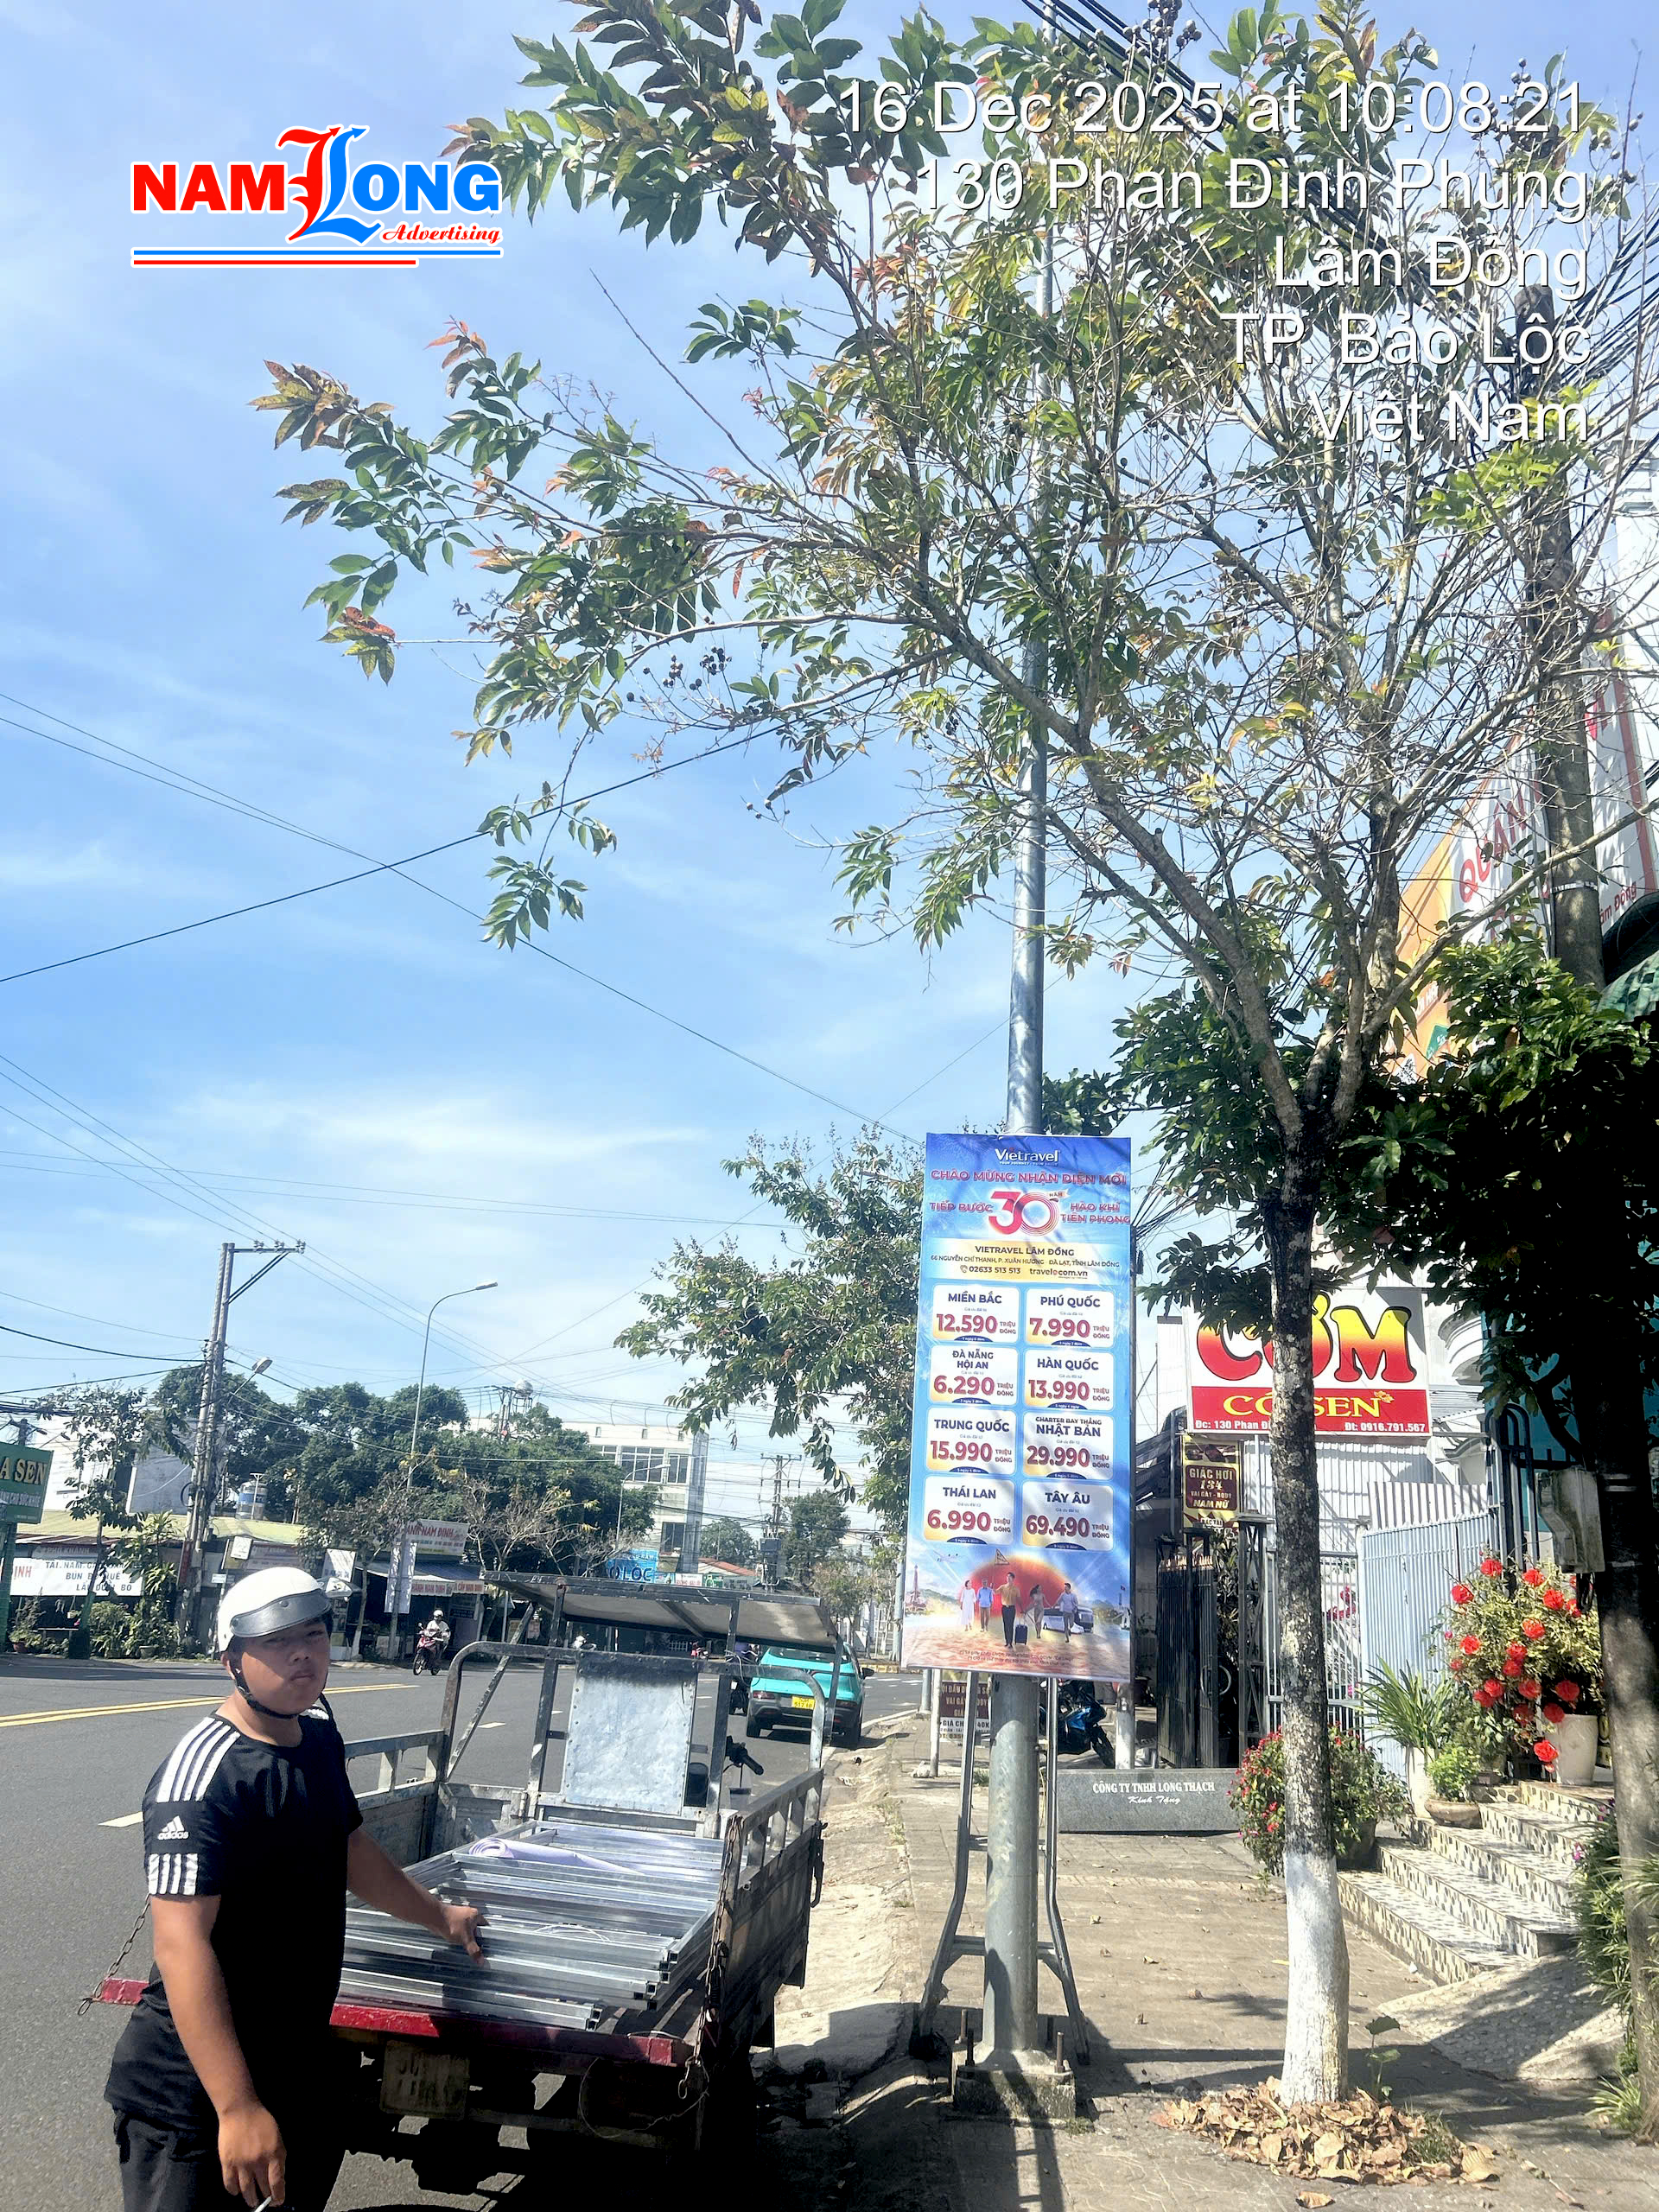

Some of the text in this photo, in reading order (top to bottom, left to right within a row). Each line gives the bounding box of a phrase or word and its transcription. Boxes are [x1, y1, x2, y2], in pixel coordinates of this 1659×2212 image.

[995, 1148, 1058, 1162] Vietravel
[988, 1191, 1059, 1236] 30
[1090, 1215, 1131, 1224] PHONG
[975, 1245, 1024, 1254] VIETRAVEL
[1047, 1247, 1075, 1256] ĐỒNG
[948, 1290, 1002, 1304] MIỀN BẮC
[1040, 1294, 1101, 1308] PHÚ QUỐC
[936, 1313, 998, 1334] 12.590
[1029, 1318, 1091, 1338] 7.990
[952, 1348, 994, 1359] ĐÀ NẴNG
[957, 1359, 988, 1370] HỘI AN
[1037, 1356, 1099, 1370] HÀN QUỐC
[933, 1375, 995, 1395] 6.290
[1028, 1379, 1090, 1402] 13.990
[934, 1418, 1009, 1433] TRUNG QUỐC
[1037, 1423, 1101, 1437] NHẬT BẢN
[1214, 1421, 1231, 1429] 130
[1234, 1421, 1258, 1430] Phan
[1360, 1422, 1426, 1433] 0916.791.567
[931, 1440, 993, 1462] 15.990
[1027, 1445, 1090, 1467] 29.990
[14, 1459, 48, 1484] SEN
[943, 1485, 996, 1499] THÁI LAN
[1045, 1491, 1090, 1504] TÂY ÂU
[927, 1509, 991, 1531] 6.990
[1026, 1514, 1090, 1537] 69.490
[1092, 1780, 1215, 1796] CÔNG TY TNHH LONG THẠCH
[158, 1831, 189, 1840] adidas
